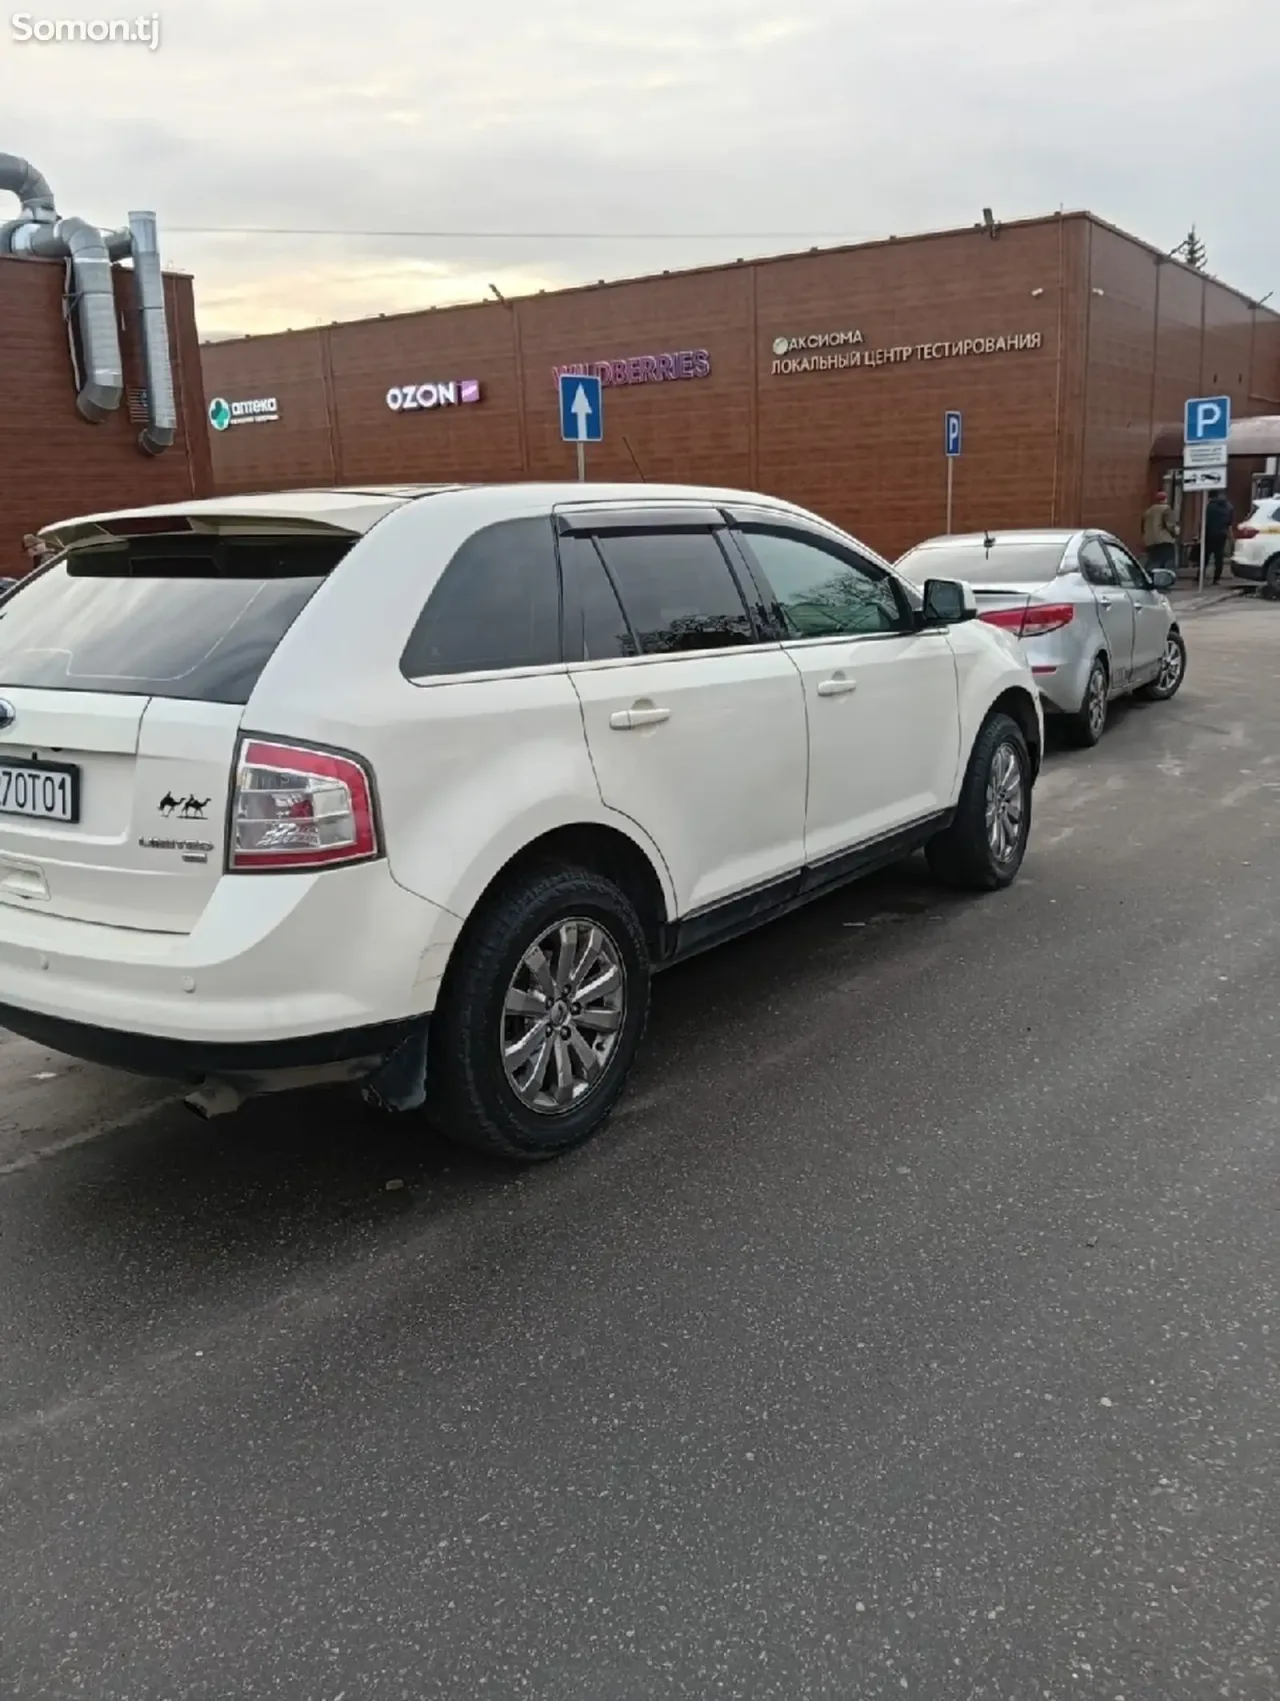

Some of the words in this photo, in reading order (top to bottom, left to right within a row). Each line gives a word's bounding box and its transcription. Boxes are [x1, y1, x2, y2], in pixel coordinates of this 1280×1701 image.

[771, 351, 861, 375] ЛОКАЛЬНЫЙ
[864, 346, 912, 368] ЦЕНТР
[916, 332, 1041, 360] ТЕСТИРОВАНИЯ
[788, 329, 864, 351] АКСИОМА
[386, 382, 457, 412] OZON
[948, 417, 960, 450] P
[1196, 402, 1222, 438] P
[0, 770, 67, 816] 70T01
